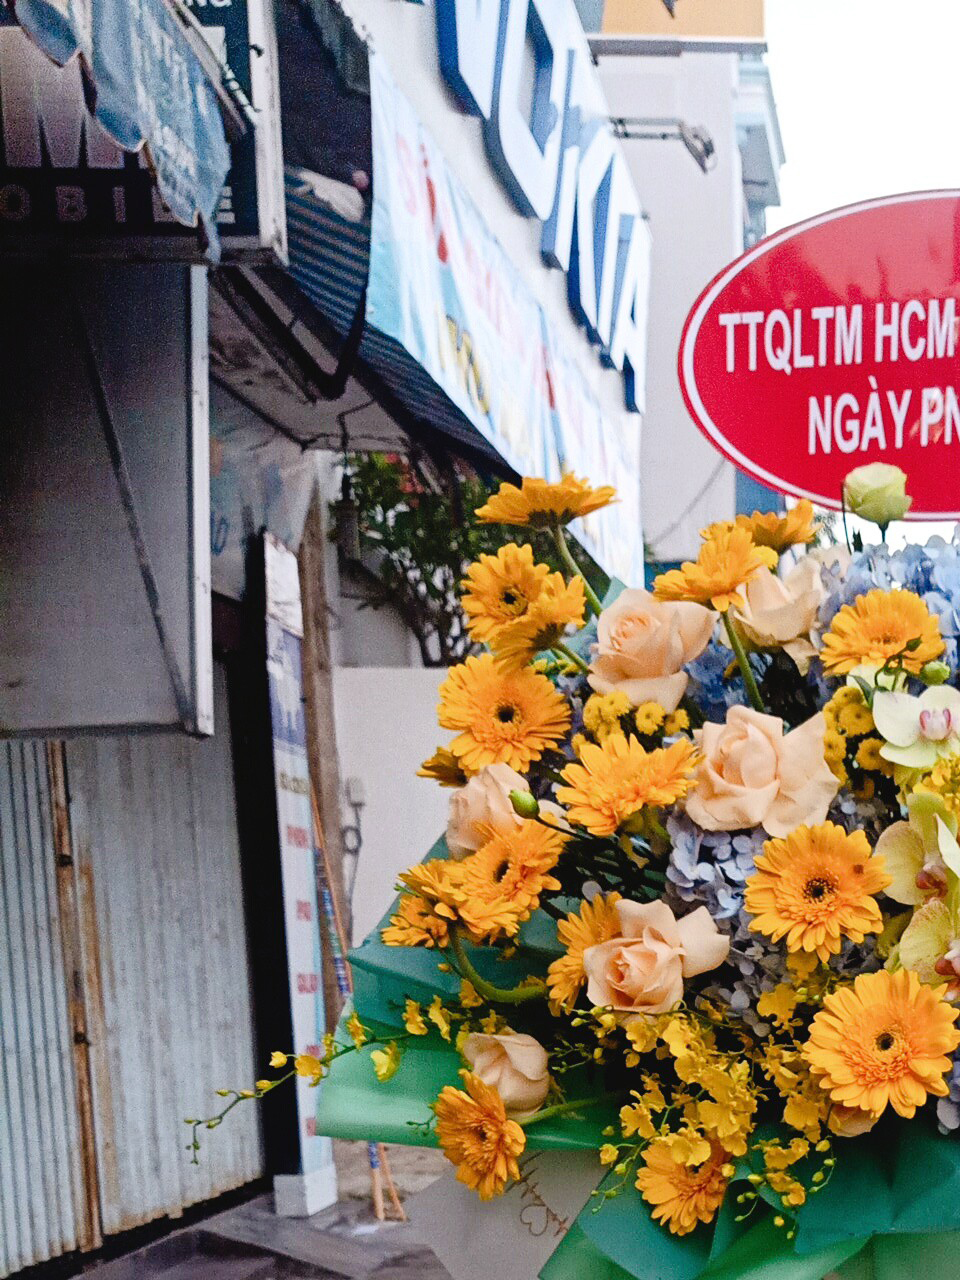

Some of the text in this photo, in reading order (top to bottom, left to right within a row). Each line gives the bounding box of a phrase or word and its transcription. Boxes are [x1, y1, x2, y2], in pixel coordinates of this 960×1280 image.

[718, 304, 863, 375] TTQLTM
[874, 297, 957, 363] HCM
[807, 374, 910, 455] NGÀY
